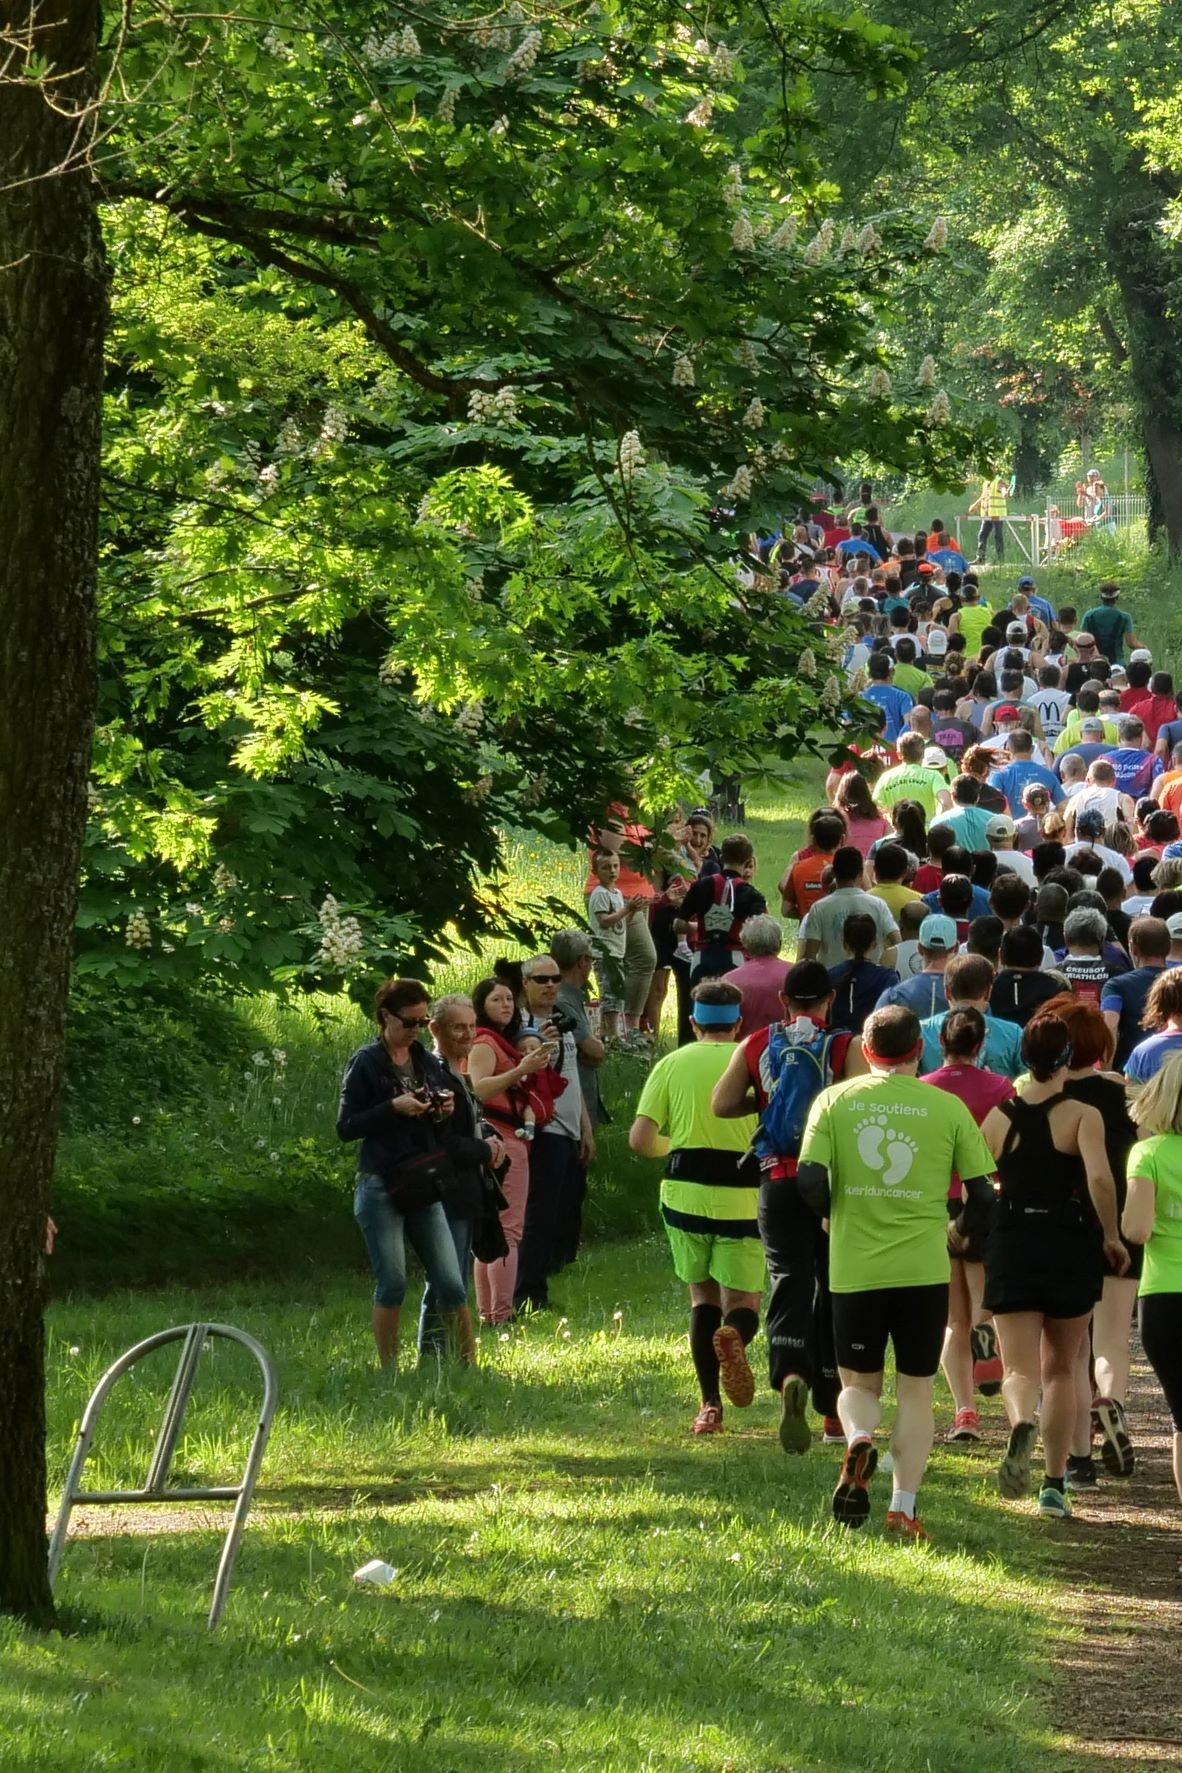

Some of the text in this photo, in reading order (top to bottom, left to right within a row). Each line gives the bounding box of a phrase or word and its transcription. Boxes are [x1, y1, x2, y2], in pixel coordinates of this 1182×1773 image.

[1066, 966, 1106, 974] CREUSOT
[1064, 972, 1109, 980] TRIATHLON
[848, 1100, 928, 1117] Je soutiens
